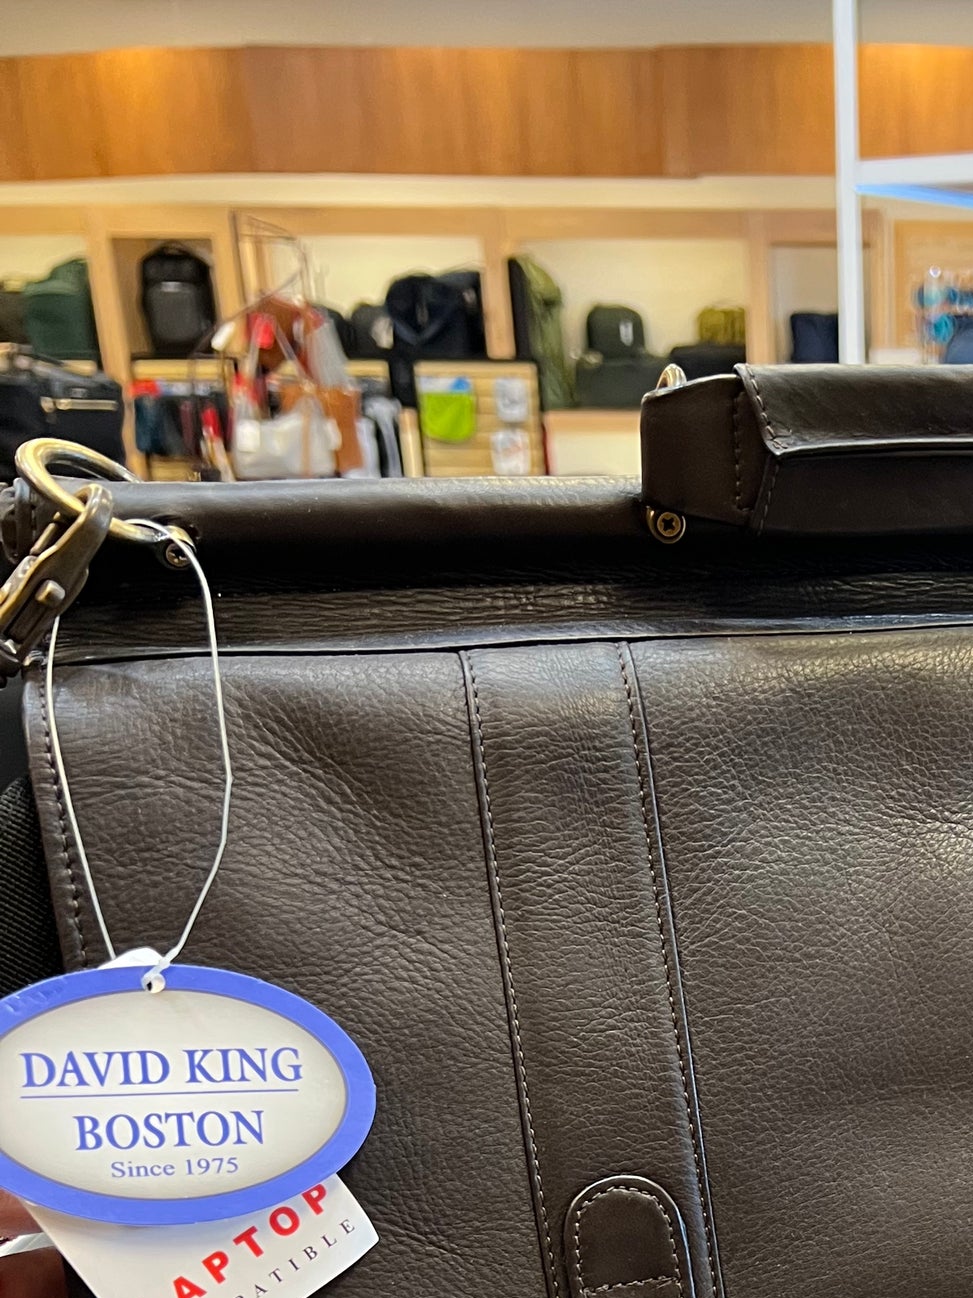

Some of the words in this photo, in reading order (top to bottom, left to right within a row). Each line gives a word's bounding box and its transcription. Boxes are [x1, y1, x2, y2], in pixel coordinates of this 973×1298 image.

[20, 1050, 170, 1088] DAVID
[183, 1046, 303, 1084] KING
[73, 1110, 264, 1152] BOSTON
[110, 1160, 176, 1179] Since
[185, 1156, 239, 1176] 1975
